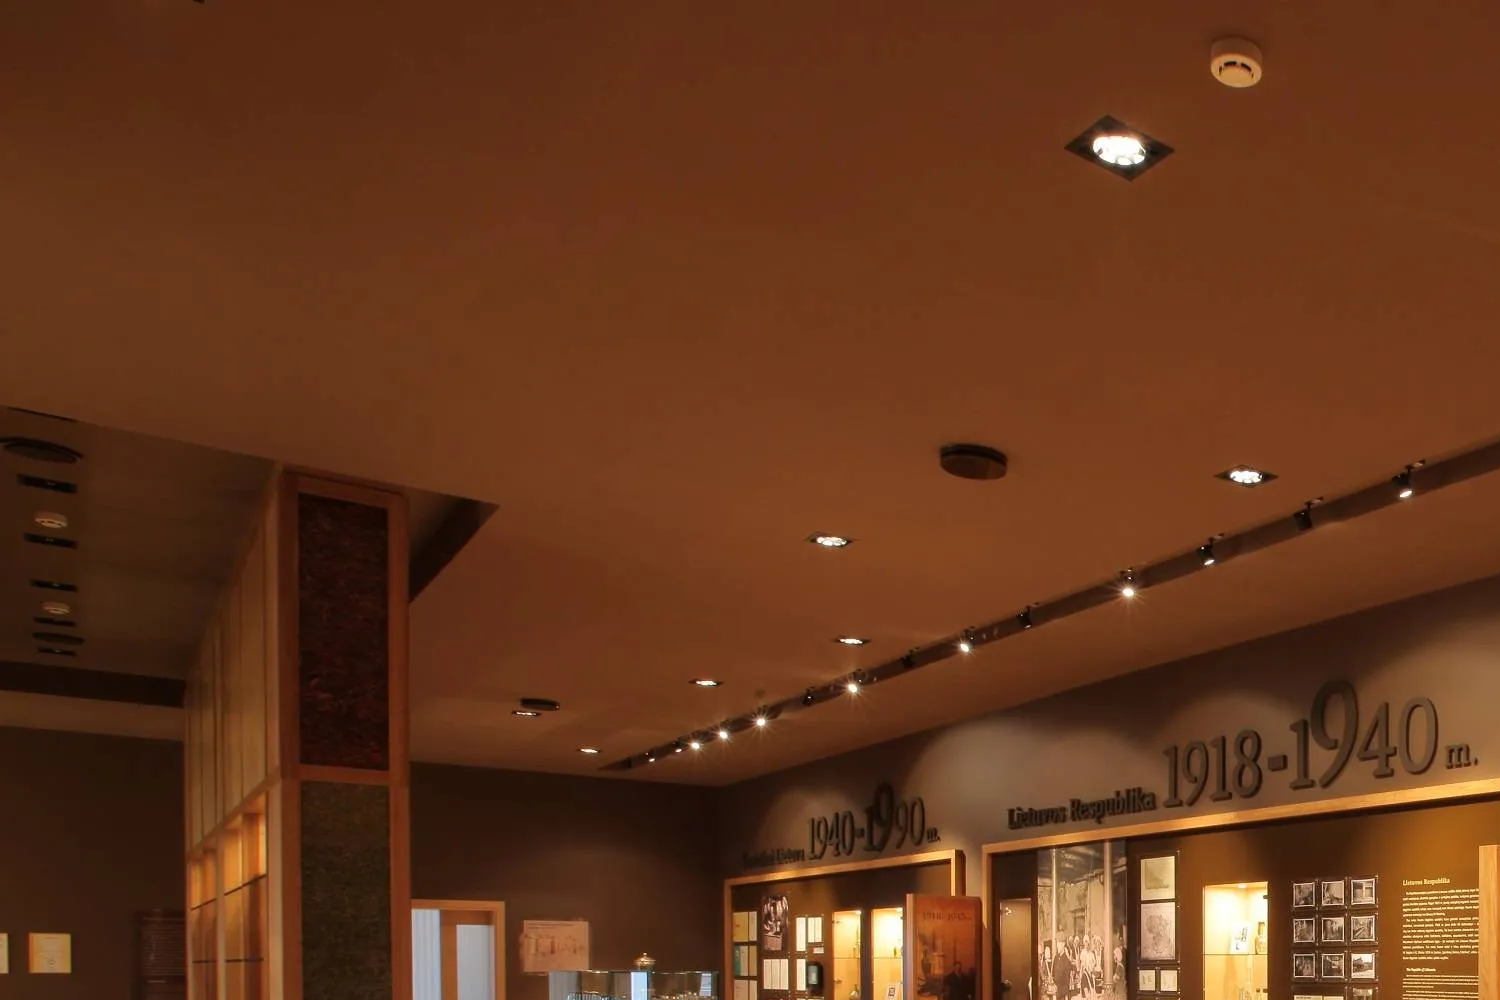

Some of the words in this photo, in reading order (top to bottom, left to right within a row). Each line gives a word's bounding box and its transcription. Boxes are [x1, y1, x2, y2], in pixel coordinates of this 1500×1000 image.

[1007, 803, 1067, 830] Lietuvos
[1070, 786, 1157, 825] Respublika
[1162, 679, 1440, 808] 1918-1940
[1444, 740, 1480, 769] m.
[808, 781, 926, 862] 1940-1990
[926, 826, 942, 843] m.
